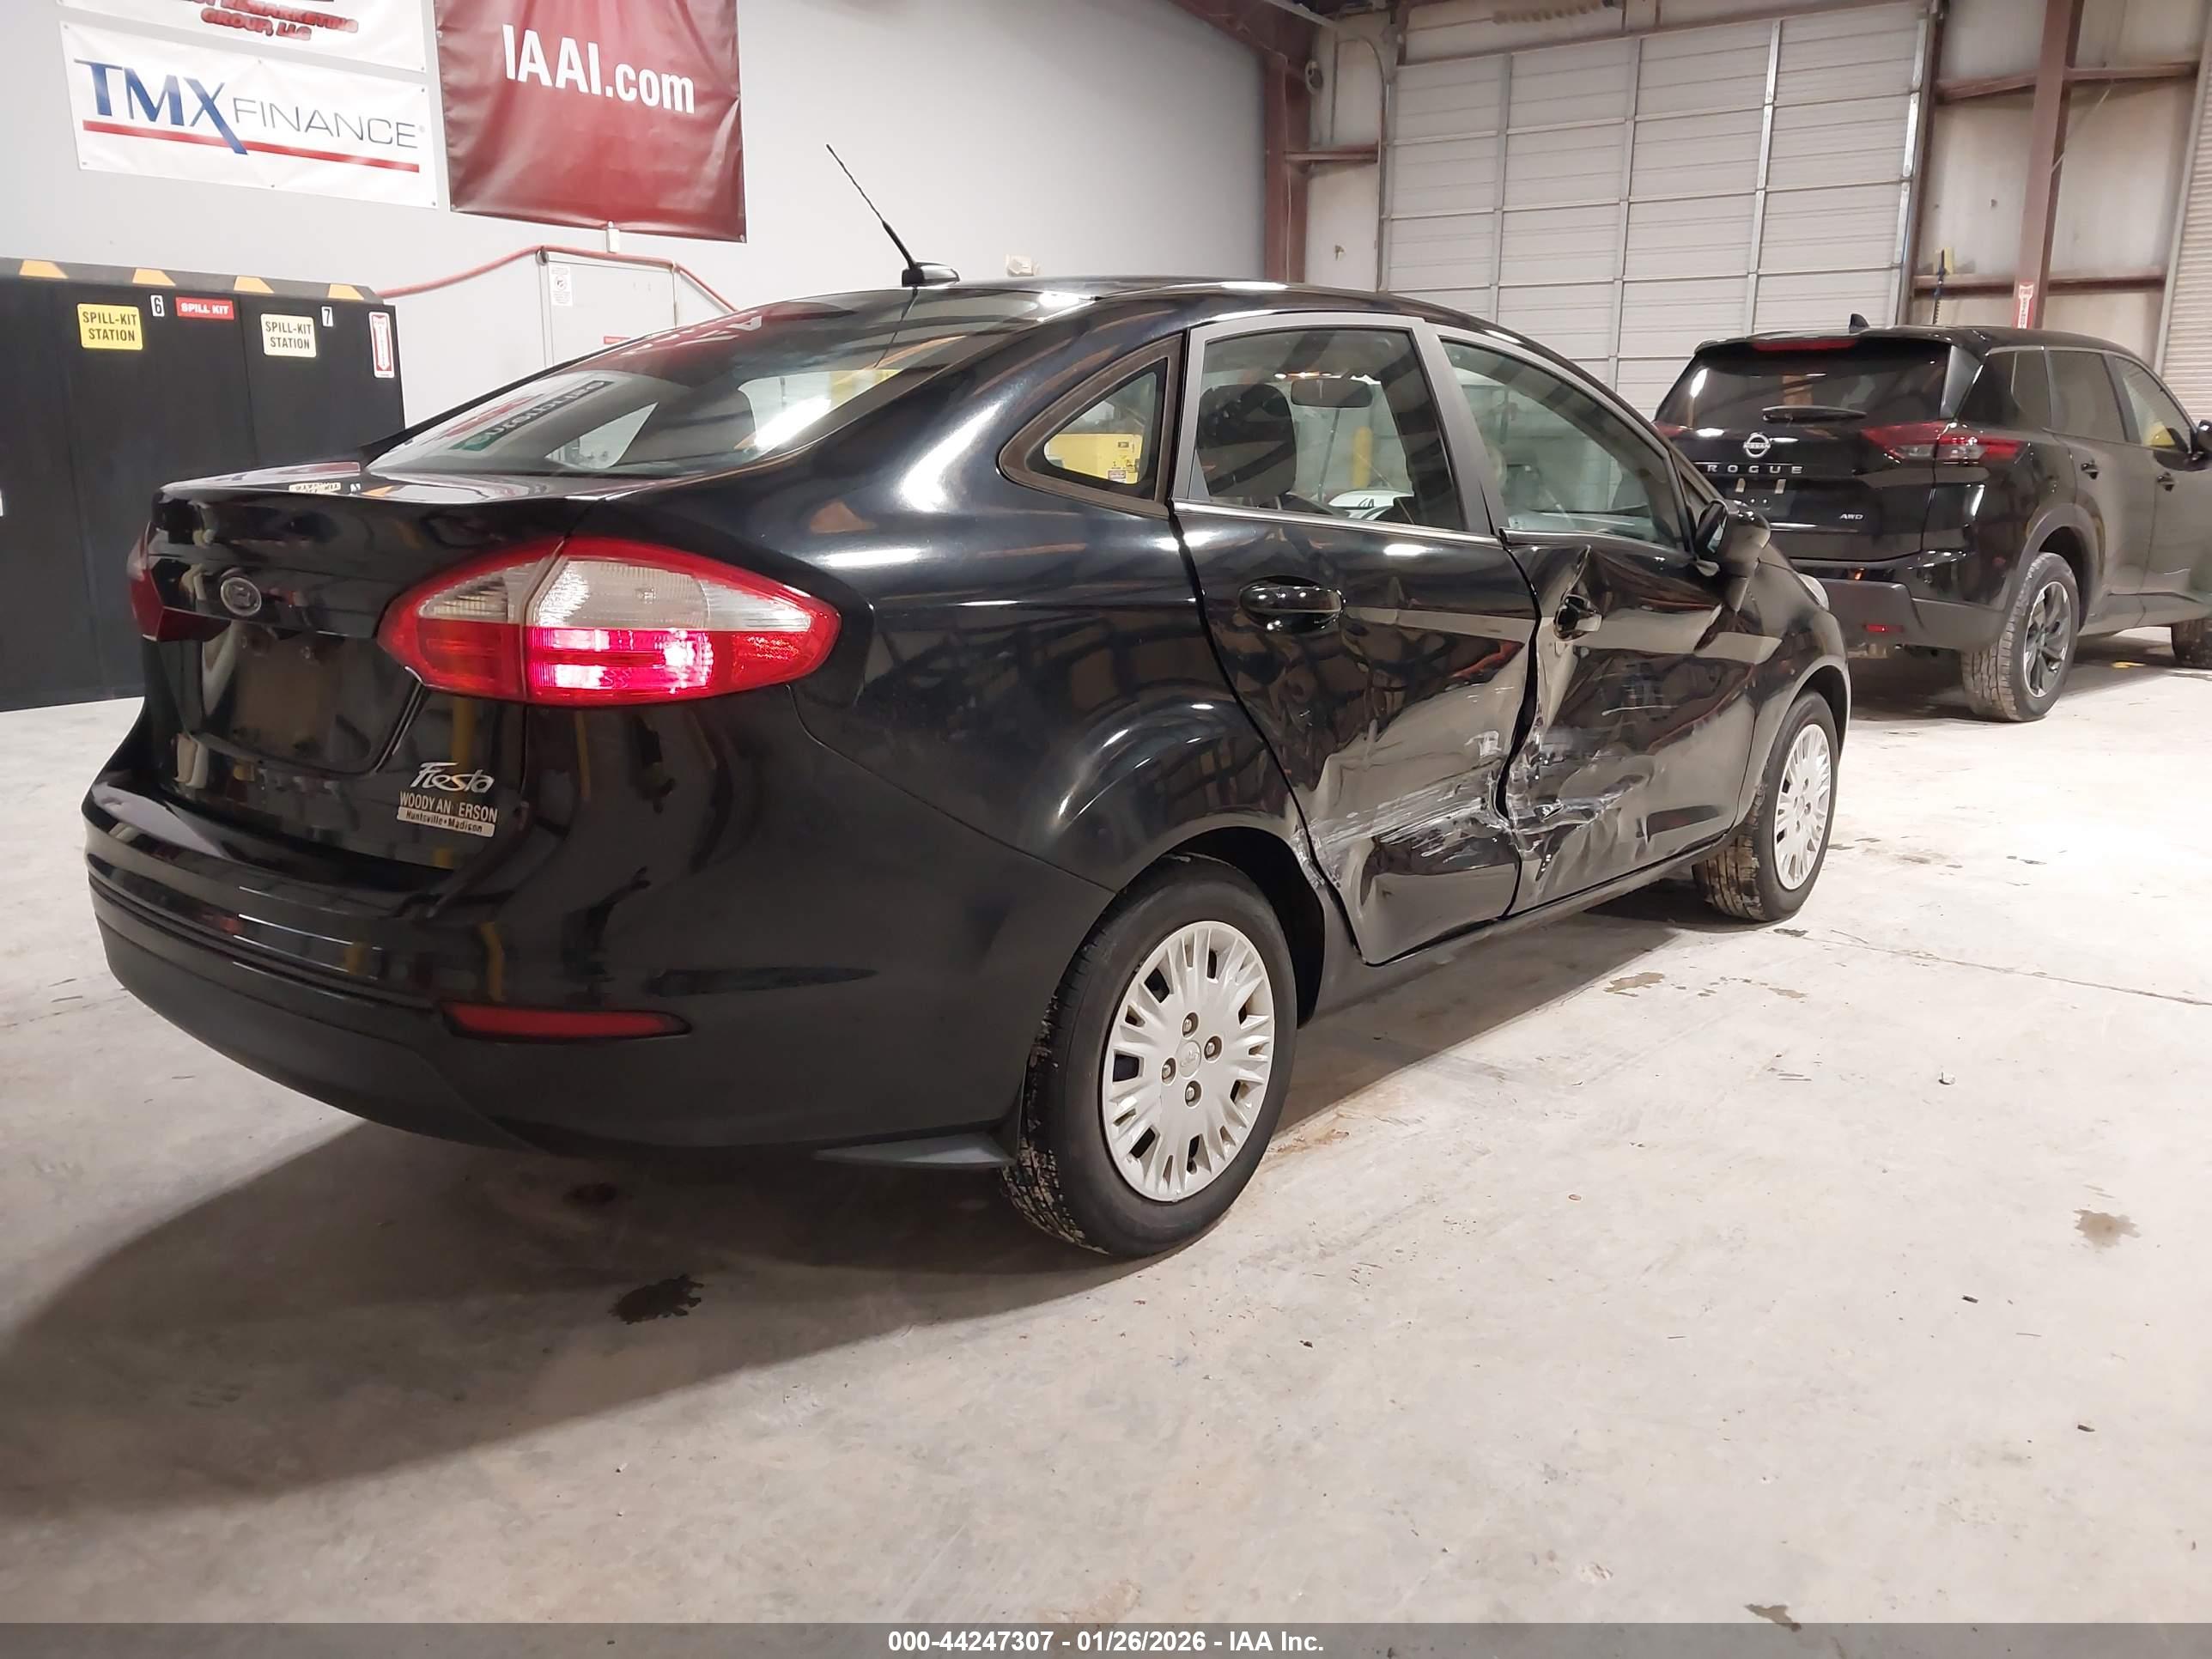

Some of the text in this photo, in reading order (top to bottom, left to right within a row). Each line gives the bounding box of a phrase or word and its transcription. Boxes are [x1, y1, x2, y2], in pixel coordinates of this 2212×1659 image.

[201, 8, 312, 40] GROUP, LLC
[502, 24, 696, 113] IAAI.com
[74, 58, 419, 155] TMX FINANCE
[154, 298, 161, 313] 6
[181, 302, 230, 315] SPILL KIT
[82, 312, 137, 325] SPILL-KIT
[324, 308, 331, 325] 7
[88, 328, 135, 341] STATION
[265, 321, 312, 335] SPILL-KIT
[270, 337, 310, 349] STATION
[1707, 465, 1803, 474] ROGUE
[410, 762, 495, 793] Fiesta
[400, 790, 436, 811] WOODY
